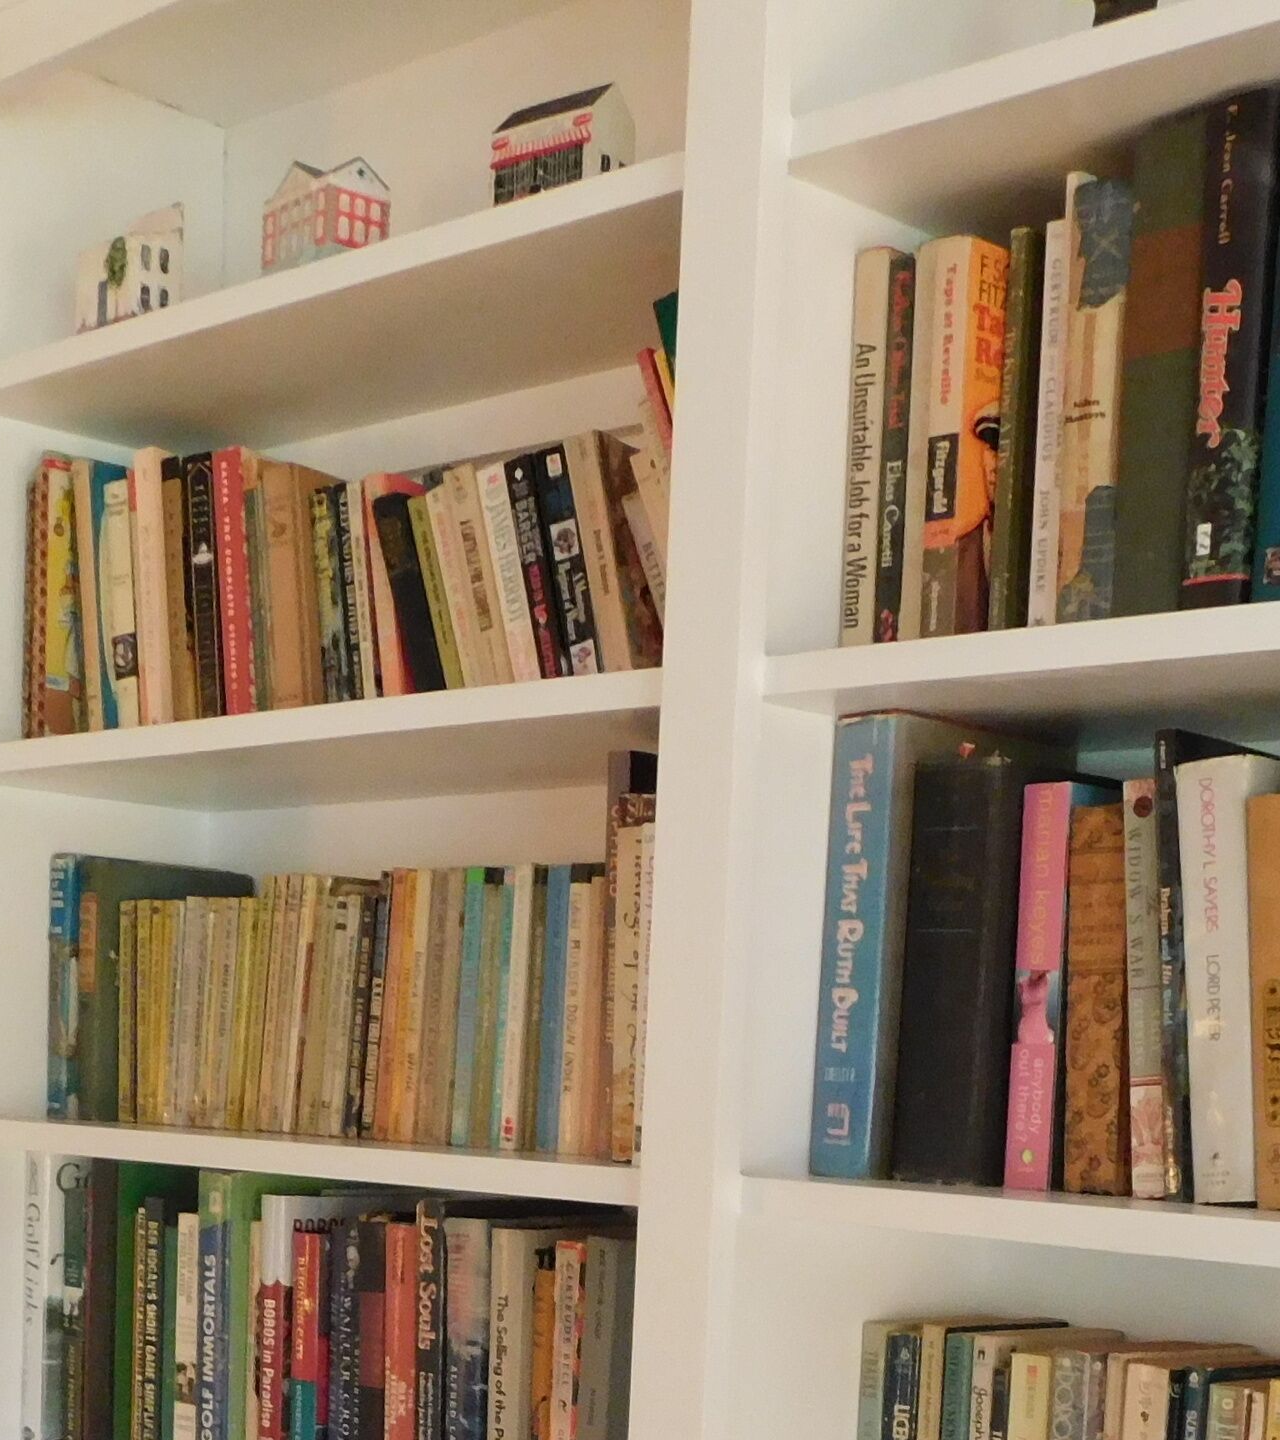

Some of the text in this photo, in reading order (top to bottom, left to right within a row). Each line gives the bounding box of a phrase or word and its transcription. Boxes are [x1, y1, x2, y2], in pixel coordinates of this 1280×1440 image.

[855, 343, 876, 370] An
[1196, 279, 1242, 448] Hunter
[849, 370, 874, 474] Unsuitable
[846, 475, 871, 509] Job
[846, 510, 870, 540] for
[487, 502, 524, 625] JAMES HERRIOT
[843, 555, 867, 629] Woman
[24, 1201, 41, 1328] Golf Links
[147, 1247, 159, 1300] HOGAN'S
[417, 1214, 439, 1352] Lost Souls
[145, 1301, 158, 1341] SHORT
[204, 1253, 217, 1377] IMMORTALS
[496, 1295, 510, 1322] The
[261, 1297, 277, 1429] BOBOS in Paradise
[494, 1324, 509, 1376] Selling
[448, 1363, 459, 1420] ALFRED
[493, 1378, 507, 1396] of
[494, 1398, 506, 1424] the
